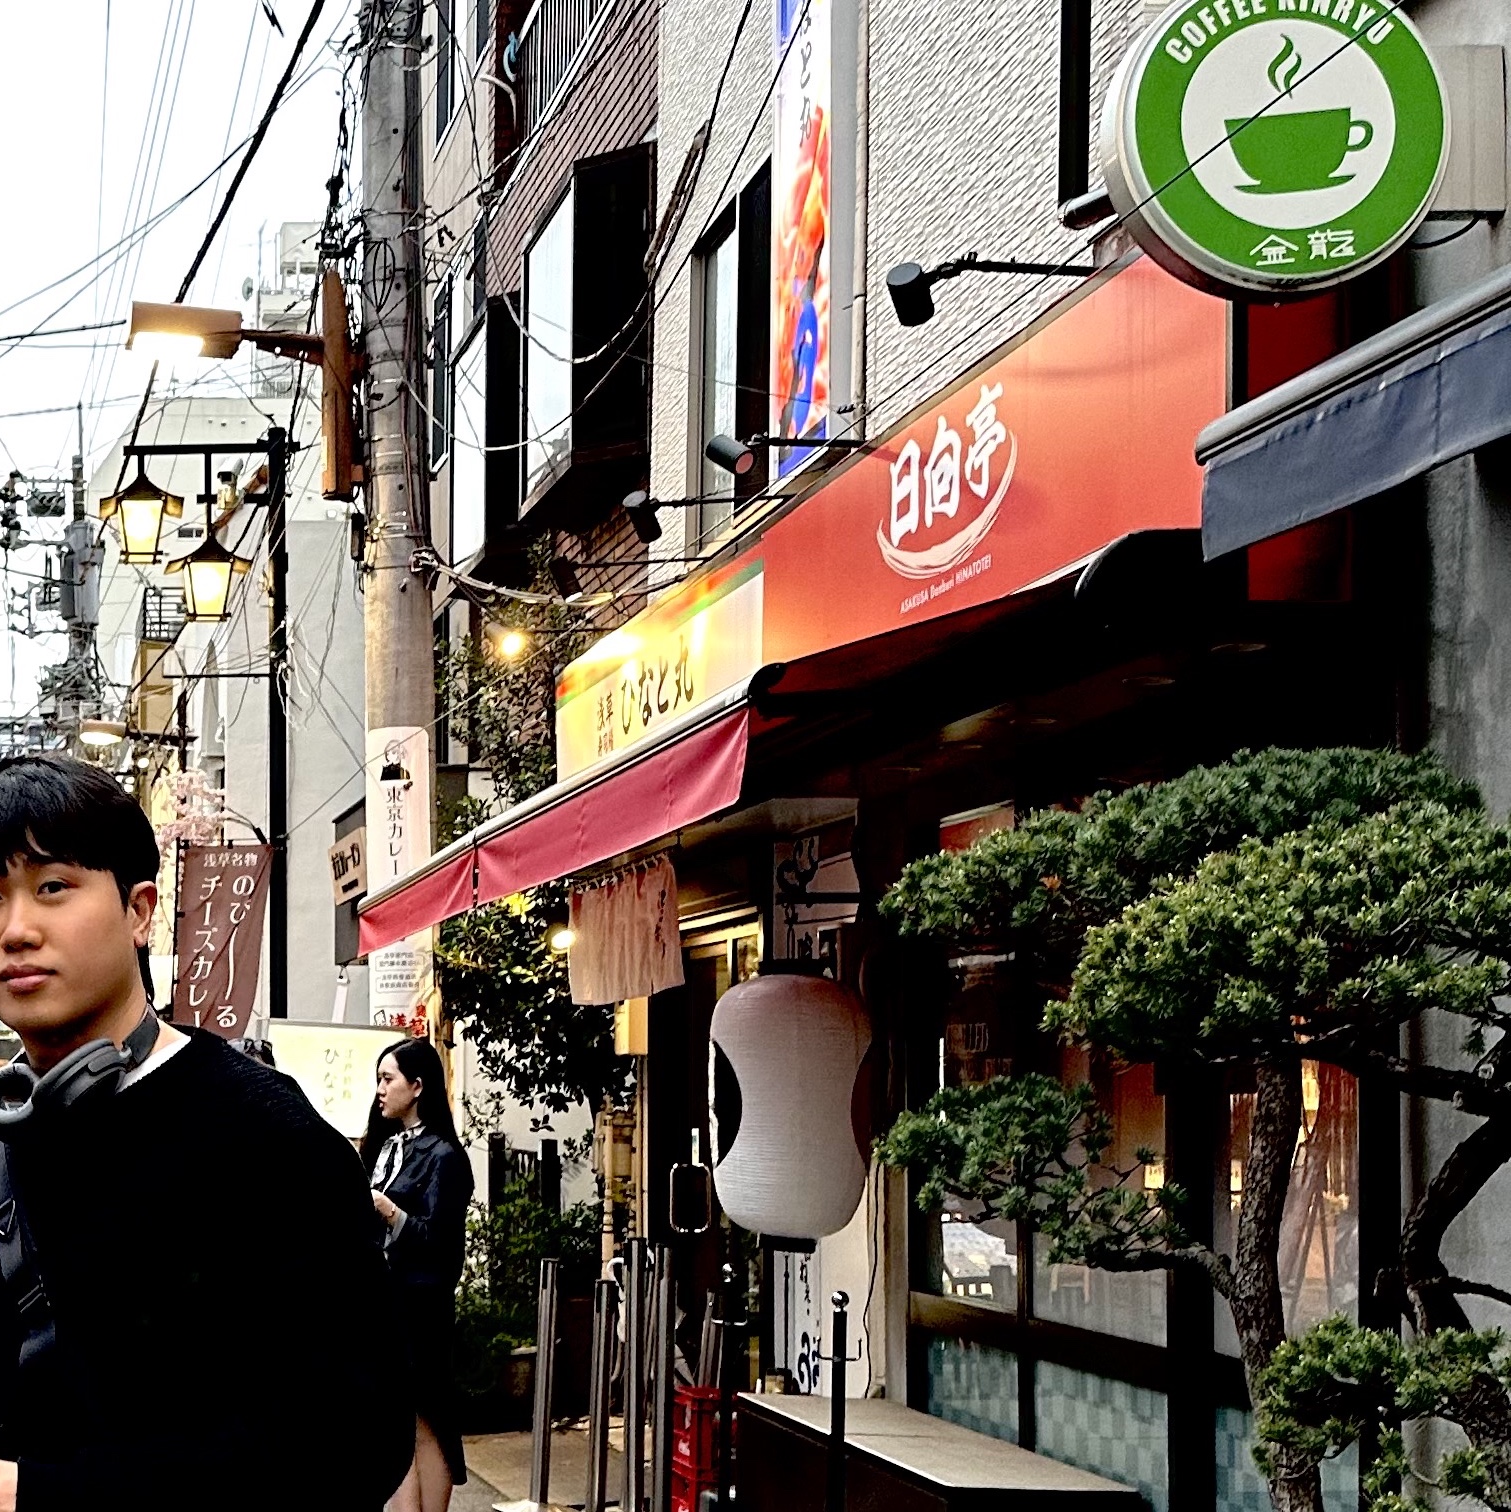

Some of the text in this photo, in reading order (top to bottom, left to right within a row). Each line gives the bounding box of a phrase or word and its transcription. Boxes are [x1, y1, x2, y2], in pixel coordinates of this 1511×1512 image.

[1165, 0, 1267, 64] COFFEE
[1250, 228, 1356, 267] 金龍
[621, 634, 694, 735] ひなと丸
[203, 853, 258, 868] 浅草名物
[386, 786, 403, 876] 東京カレー
[188, 875, 223, 1028] チーズカレー
